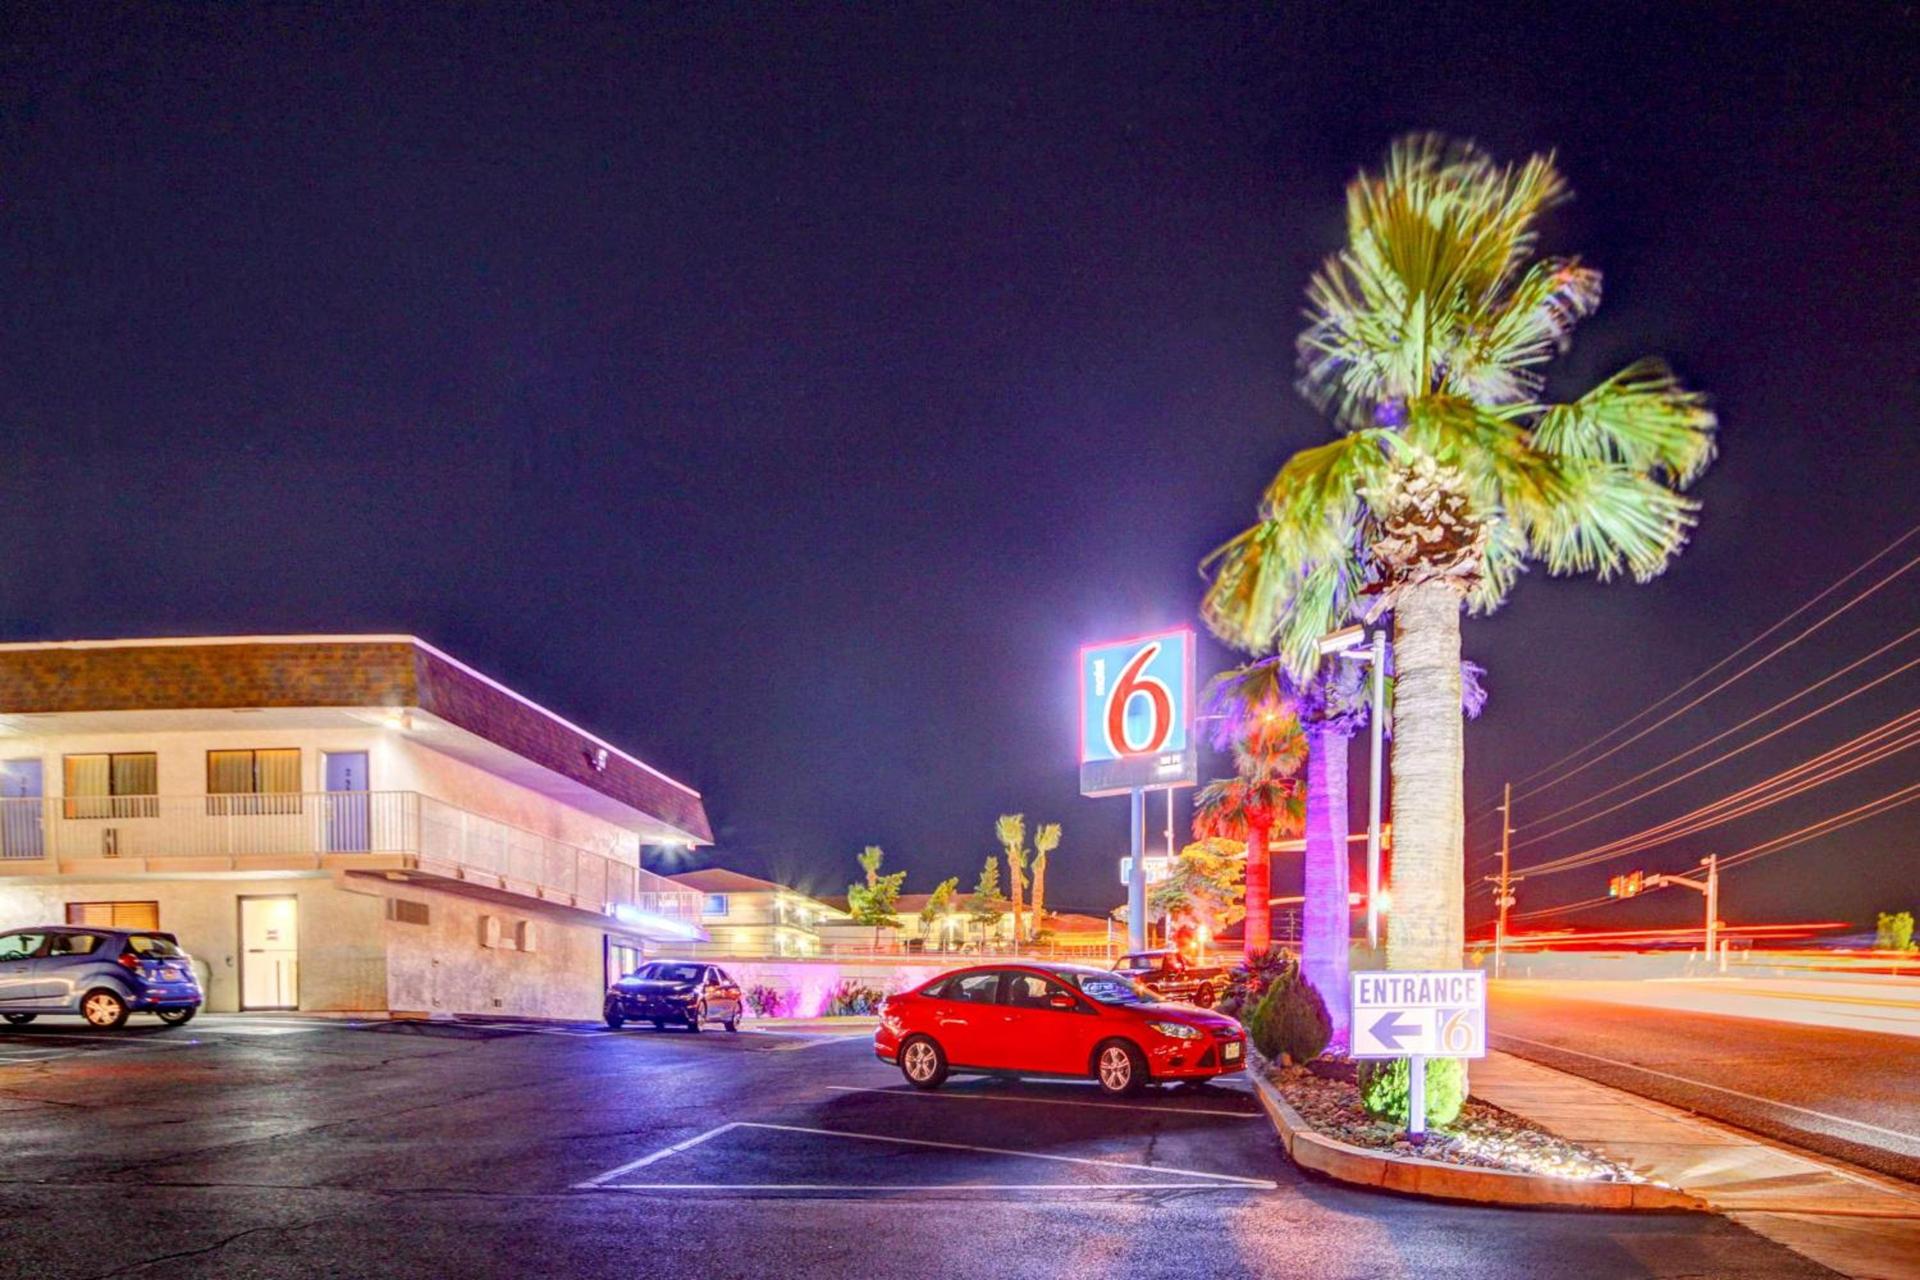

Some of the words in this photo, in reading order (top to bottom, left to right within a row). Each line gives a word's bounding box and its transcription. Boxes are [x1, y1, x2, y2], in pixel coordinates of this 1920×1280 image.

[1105, 642, 1175, 757] 6
[1360, 978, 1477, 1004] ENTRANCE
[1443, 1009, 1473, 1052] 6
